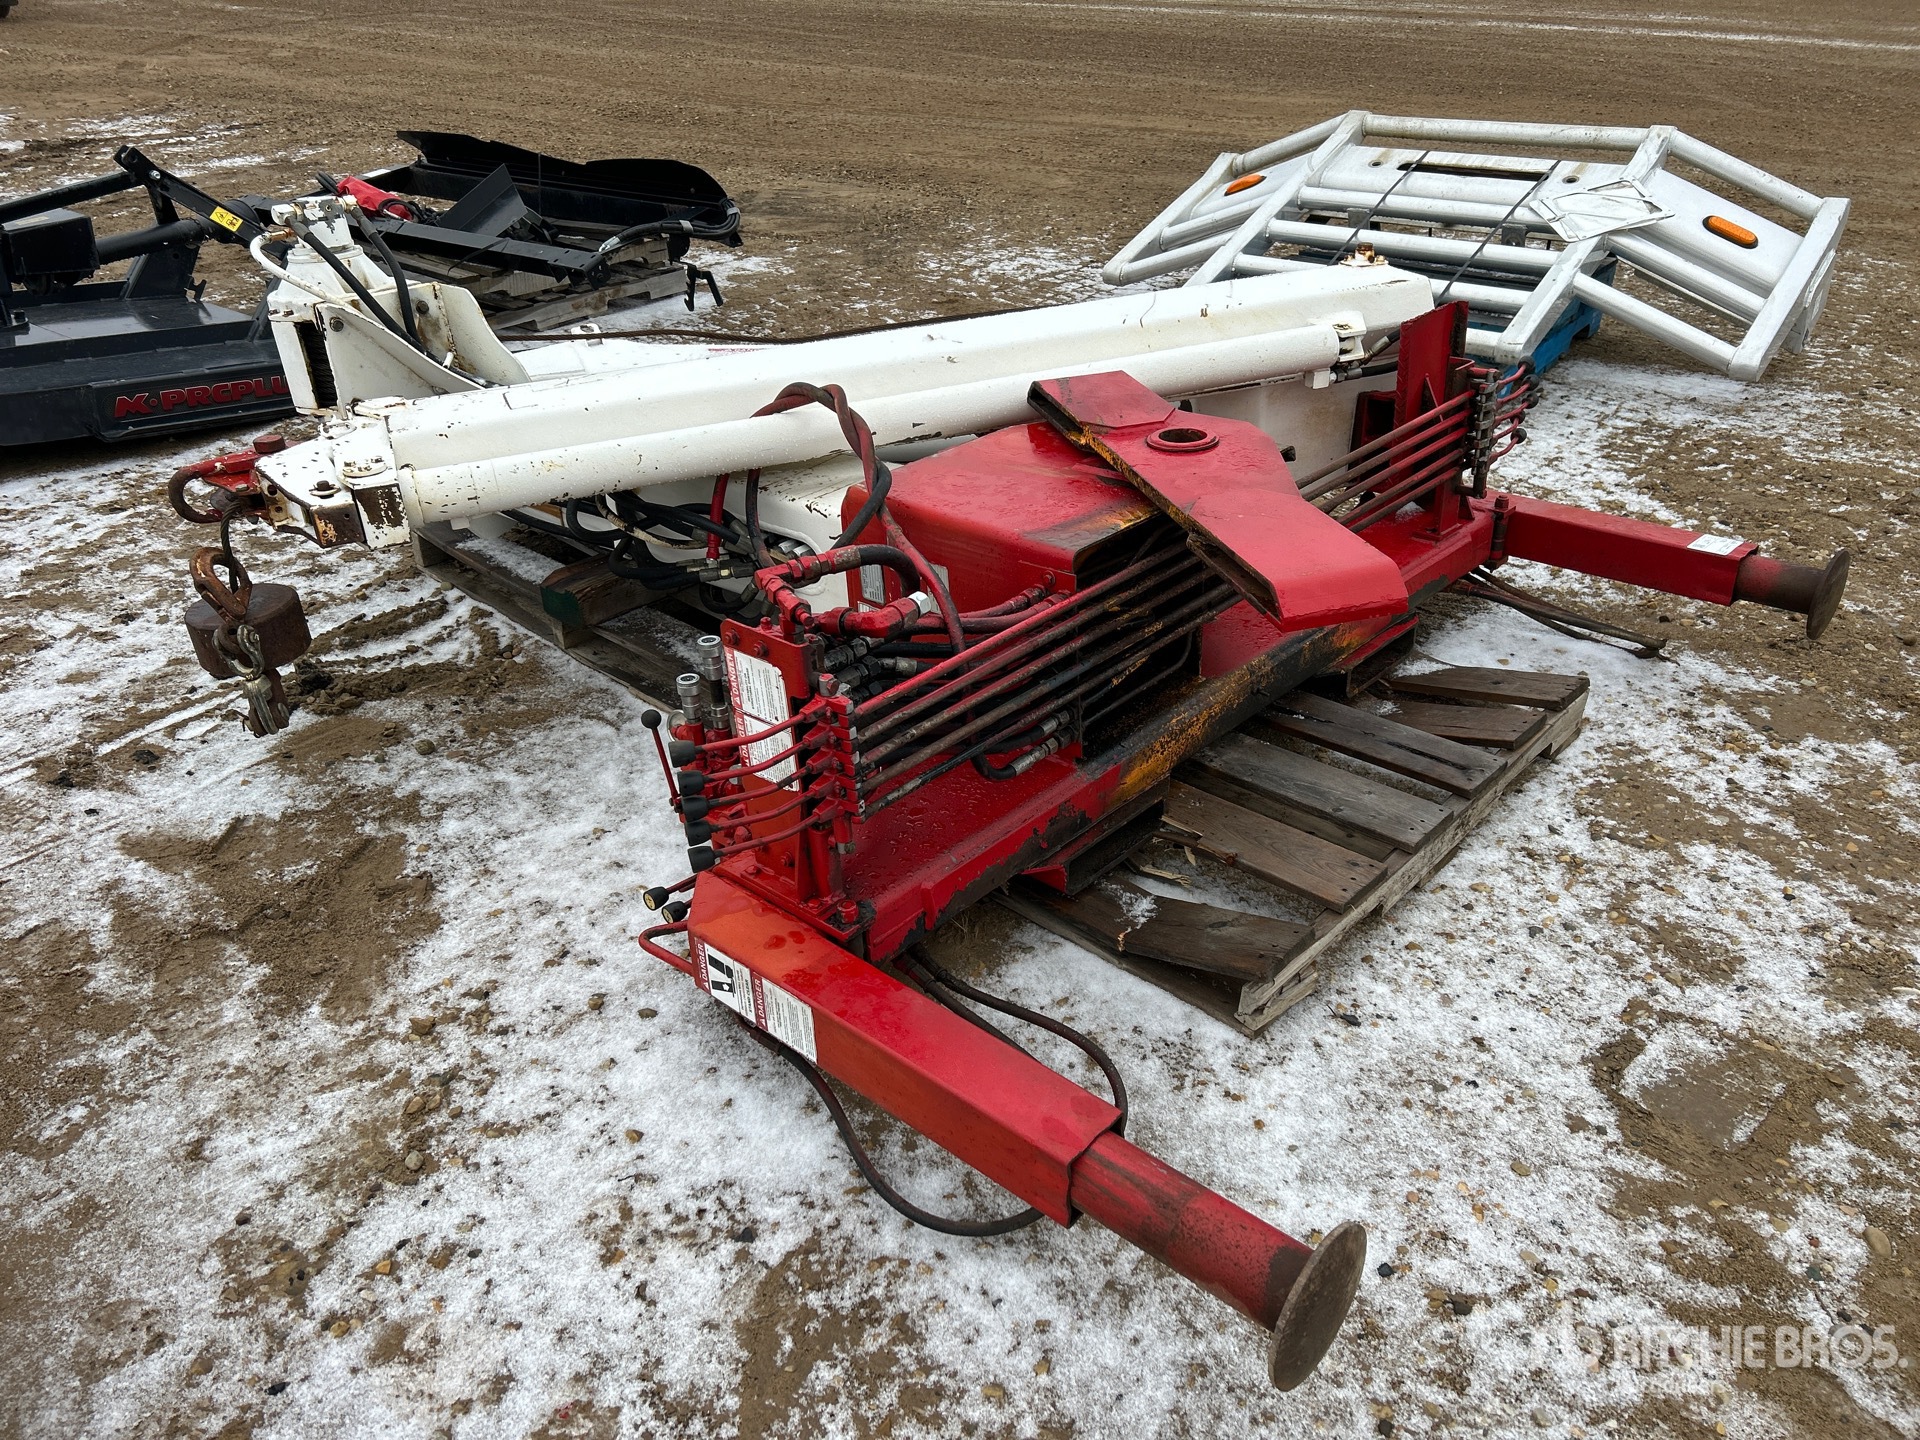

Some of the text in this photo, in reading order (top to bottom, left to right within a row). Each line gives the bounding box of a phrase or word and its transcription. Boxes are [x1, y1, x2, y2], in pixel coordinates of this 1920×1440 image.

[726, 652, 739, 694] DANGER
[736, 717, 748, 759] DAGER
[697, 943, 709, 982] DANGER
[754, 979, 766, 1018] DANGER
